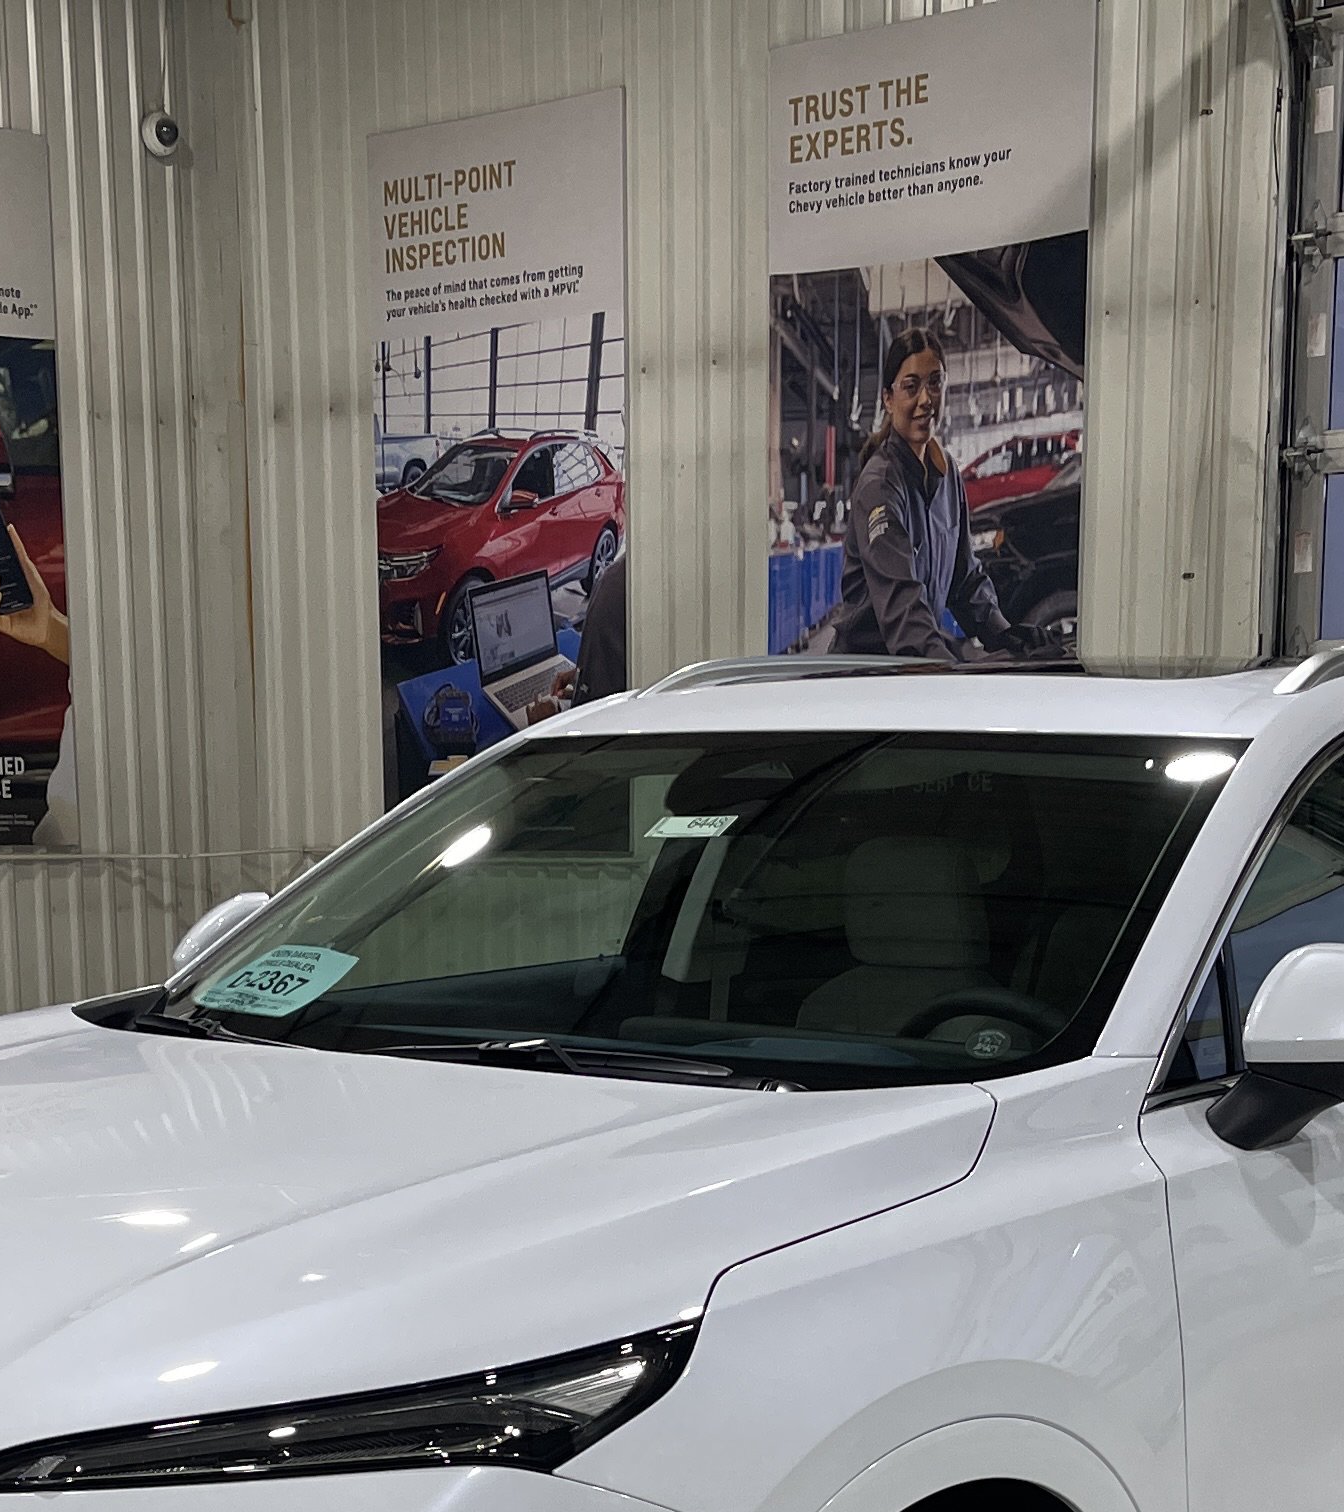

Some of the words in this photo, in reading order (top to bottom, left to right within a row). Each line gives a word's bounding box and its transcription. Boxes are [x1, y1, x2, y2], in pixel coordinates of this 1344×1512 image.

[789, 84, 871, 126] TRUST
[878, 73, 929, 110] THE
[789, 117, 913, 164] EXPERTS.
[383, 159, 516, 207] MULTI-POINT
[788, 176, 832, 195] Factory
[834, 170, 875, 189] trained
[879, 161, 946, 182] technicians
[949, 155, 980, 171] know
[983, 148, 1012, 167] your
[788, 199, 823, 215] Chevy
[825, 192, 865, 210] vehicle
[868, 187, 905, 204] better
[907, 183, 934, 198] than
[937, 175, 984, 194] anyone.
[383, 203, 468, 240] VEHICLE
[385, 231, 506, 274] INSPECTION
[385, 289, 402, 302] The
[404, 287, 430, 302] peace
[432, 282, 442, 296] of
[444, 280, 466, 294] mind
[469, 277, 488, 291] that
[490, 275, 520, 288] comes
[522, 270, 546, 284] from
[548, 264, 584, 282] getting
[386, 307, 406, 322] your
[408, 299, 446, 315] vehicle's
[448, 296, 477, 311] health
[479, 291, 518, 307] checked
[520, 287, 541, 301] with
[543, 288, 550, 298] a
[227, 970, 310, 997] D-2367
